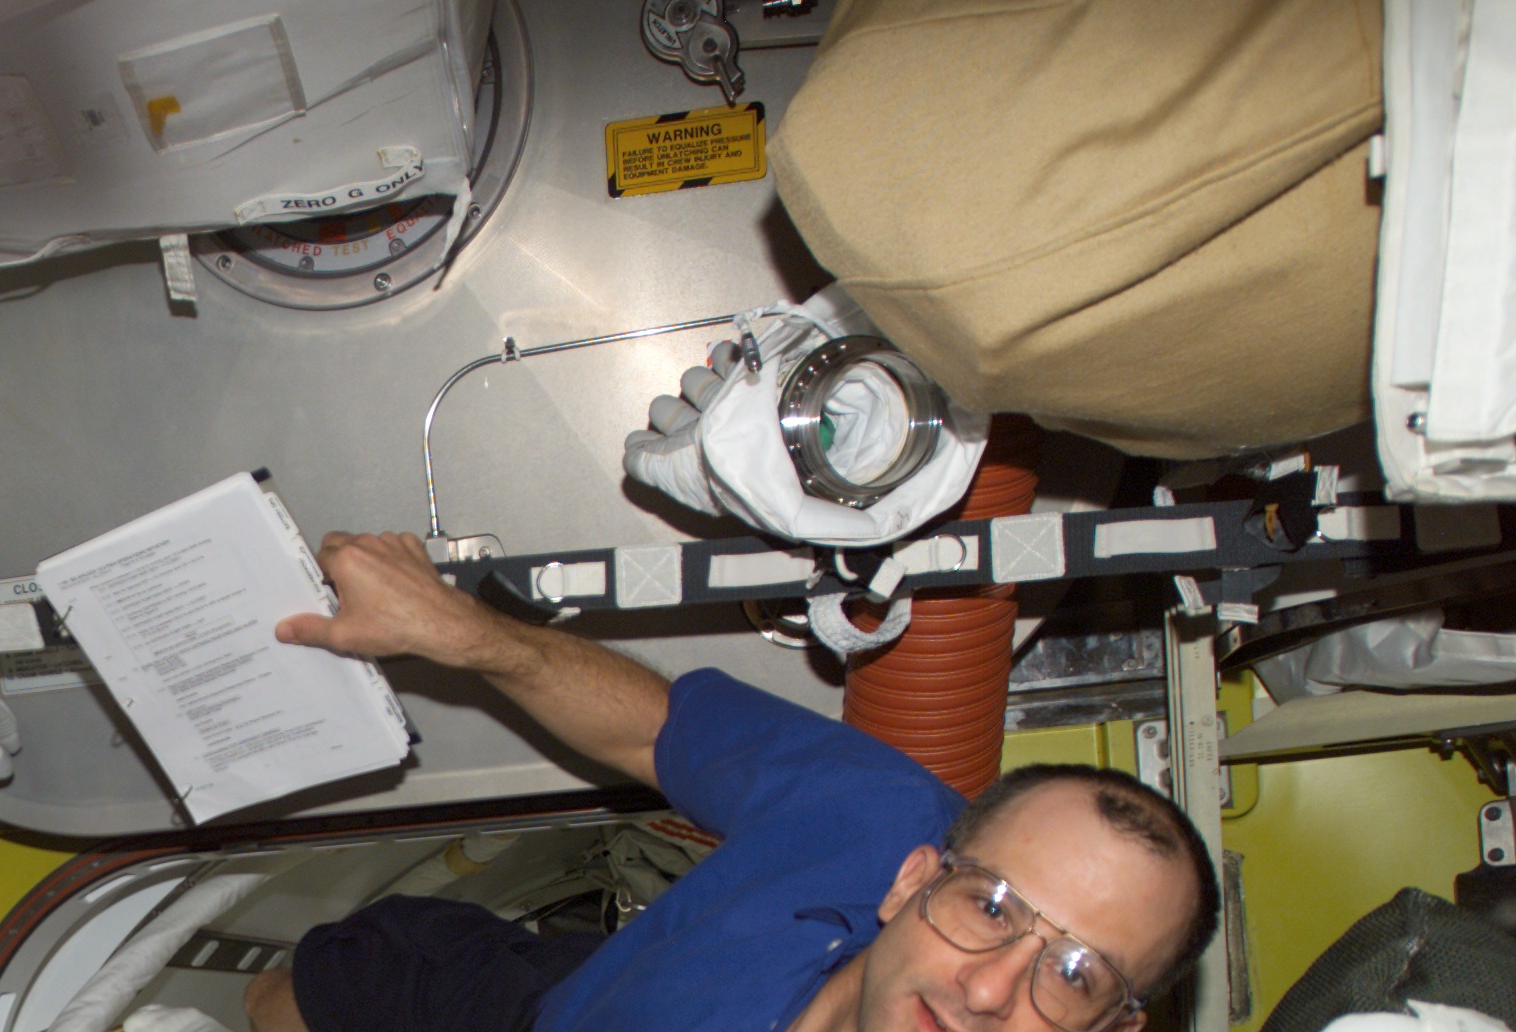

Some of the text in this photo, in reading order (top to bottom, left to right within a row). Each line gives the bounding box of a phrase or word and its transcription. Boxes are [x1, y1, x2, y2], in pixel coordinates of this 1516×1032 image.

[647, 123, 722, 145] WARNING
[622, 133, 751, 158] FAILURE TO EQUALIZE PRESSURE
[622, 144, 729, 166] BEFORE UNLATCHING CAN
[623, 151, 742, 173] RESULT IN CREW INJURY AND
[623, 162, 708, 180] EQUIPMENT DAMAGE.
[280, 159, 424, 209] ZERO G ONLY
[333, 239, 369, 256] TEST
